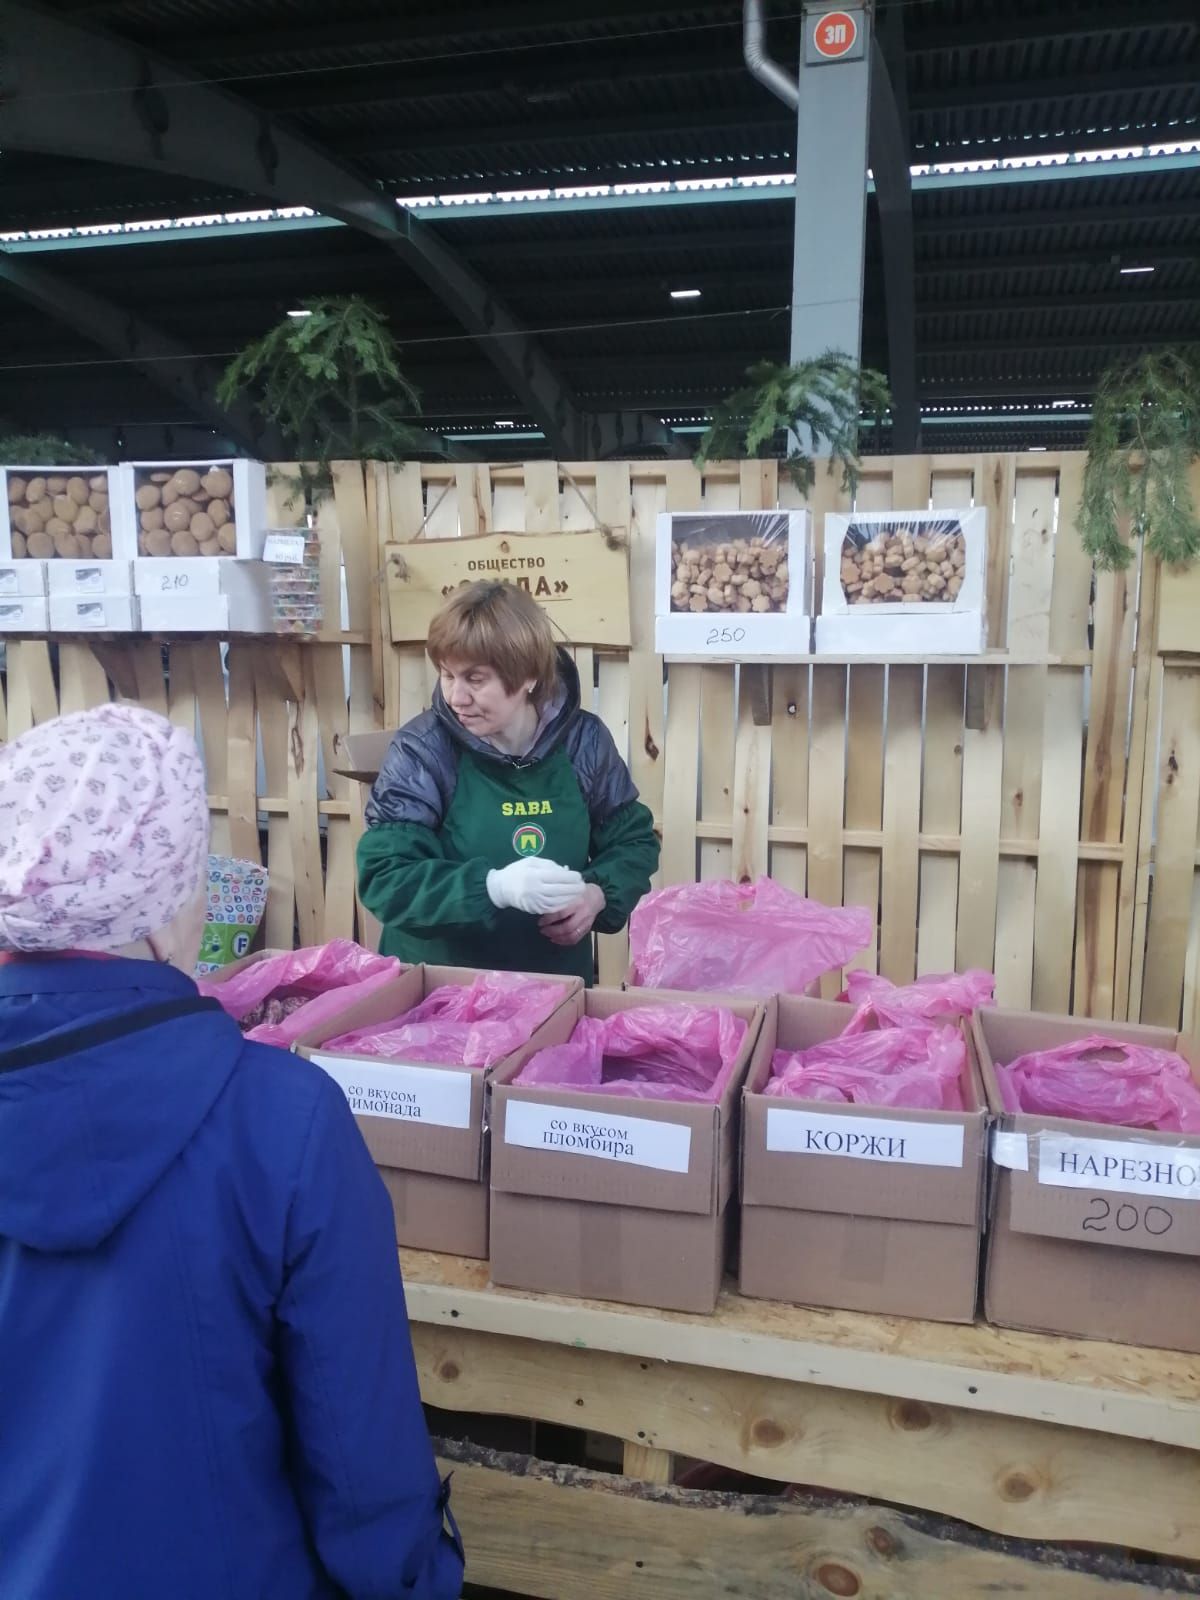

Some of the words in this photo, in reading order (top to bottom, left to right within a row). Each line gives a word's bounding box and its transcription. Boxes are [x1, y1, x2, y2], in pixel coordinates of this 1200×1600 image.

[468, 556, 545, 572] ОБЩЕСТВО
[161, 574, 188, 591] 210
[706, 627, 745, 645] 250
[501, 800, 553, 816] SABA
[237, 937, 248, 953] F
[348, 1085, 363, 1096] со
[367, 1087, 416, 1103] вкусом
[347, 1097, 421, 1117] имонада
[550, 1119, 567, 1130] со
[573, 1121, 628, 1140] вкусом
[543, 1131, 634, 1157] пломбира
[805, 1129, 907, 1158] КОРЖИ
[1060, 1152, 1200, 1186] НАРЕЗНО
[1082, 1198, 1172, 1235] 200
